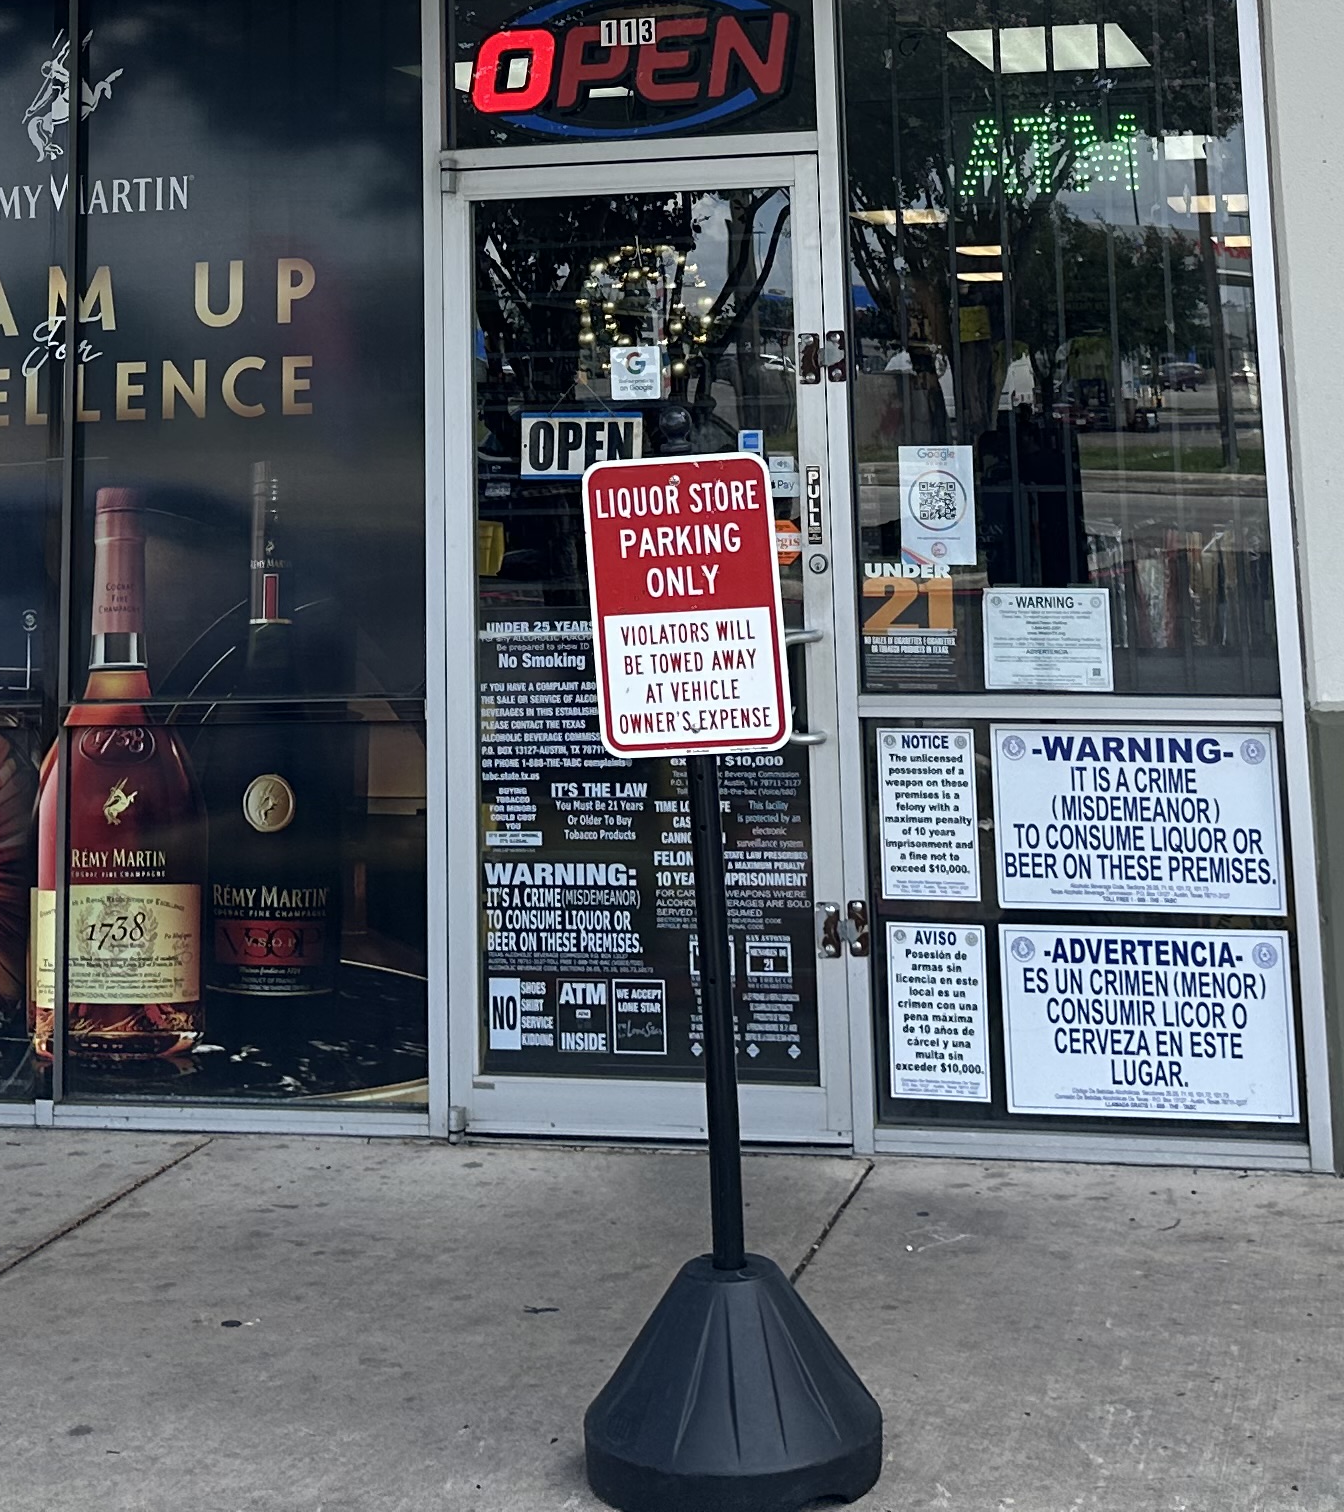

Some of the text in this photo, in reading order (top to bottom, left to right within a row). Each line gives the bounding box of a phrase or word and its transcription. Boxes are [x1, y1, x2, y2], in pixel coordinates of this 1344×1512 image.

[603, 18, 654, 46] 113
[471, 12, 790, 113] OPEN
[959, 114, 1139, 196] ATM
[50, 172, 188, 215] MARTIN
[193, 258, 317, 328] UP
[528, 421, 634, 471] OPEN
[917, 448, 955, 460] Google
[777, 480, 795, 491] Pay
[595, 480, 760, 519] LIQUOR STORE
[808, 471, 820, 526] PULL
[619, 523, 741, 559] PARKING
[647, 564, 719, 598] ONLY
[864, 563, 952, 579] UNDER
[862, 577, 954, 629] 21
[1016, 596, 1074, 608] WARNING
[486, 622, 529, 633] UNDER
[533, 622, 550, 632] 25
[620, 620, 755, 646] VIOLATORS WILL
[498, 652, 586, 670] No Smoking
[624, 648, 756, 675] BE TOWED AWAY
[646, 679, 740, 704] AT VEHICLE
[619, 707, 772, 734] OWNER'S EXPENSE
[901, 735, 949, 749] NOTICE
[725, 756, 783, 767] $10,000
[889, 754, 963, 763] The unlicensed
[889, 766, 942, 776] possession
[946, 766, 955, 775] of
[1071, 766, 1197, 794] IT IS A CRIME
[551, 782, 647, 798] IT'S THE LAW
[885, 780, 923, 788] weapon
[941, 779, 968, 787] these
[556, 801, 644, 811] You Must Be 21 Years
[568, 815, 632, 827] Or Older To Buy
[564, 830, 636, 840] Tobacco Products
[886, 838, 952, 849] imprisonment
[1013, 824, 1264, 855] TO CONSUME LIQUOR OR
[72, 848, 166, 868] RÉMY MARTIN
[891, 864, 926, 872] exceed
[1005, 852, 1277, 885] BEER ON THESE PREMISES.
[484, 863, 637, 886] WARNING:
[213, 884, 327, 908] RÉMY MARTIN
[486, 887, 641, 909] IT'S A CRIME (MISDEMEANOR)
[86, 911, 146, 950] 1738
[486, 910, 631, 932] TO CONSUME LIQUOR OR
[487, 932, 644, 953] BEER ON THESE PREMISES.
[915, 930, 957, 945] AVISO
[906, 949, 967, 960] Posesión de
[896, 973, 978, 986] licencia en este
[1023, 967, 1266, 999] ES UN CRIMEN (MENOR)
[559, 983, 606, 1005] ATM
[492, 995, 517, 1030] NO
[1047, 998, 1247, 1029] CONSUMIR LICOR O
[561, 1033, 606, 1051] INSIDE
[1054, 1027, 1243, 1059] CERVEZA EN ESTE
[896, 1062, 937, 1072] exceder
[1112, 1059, 1189, 1087] LUGAR.
